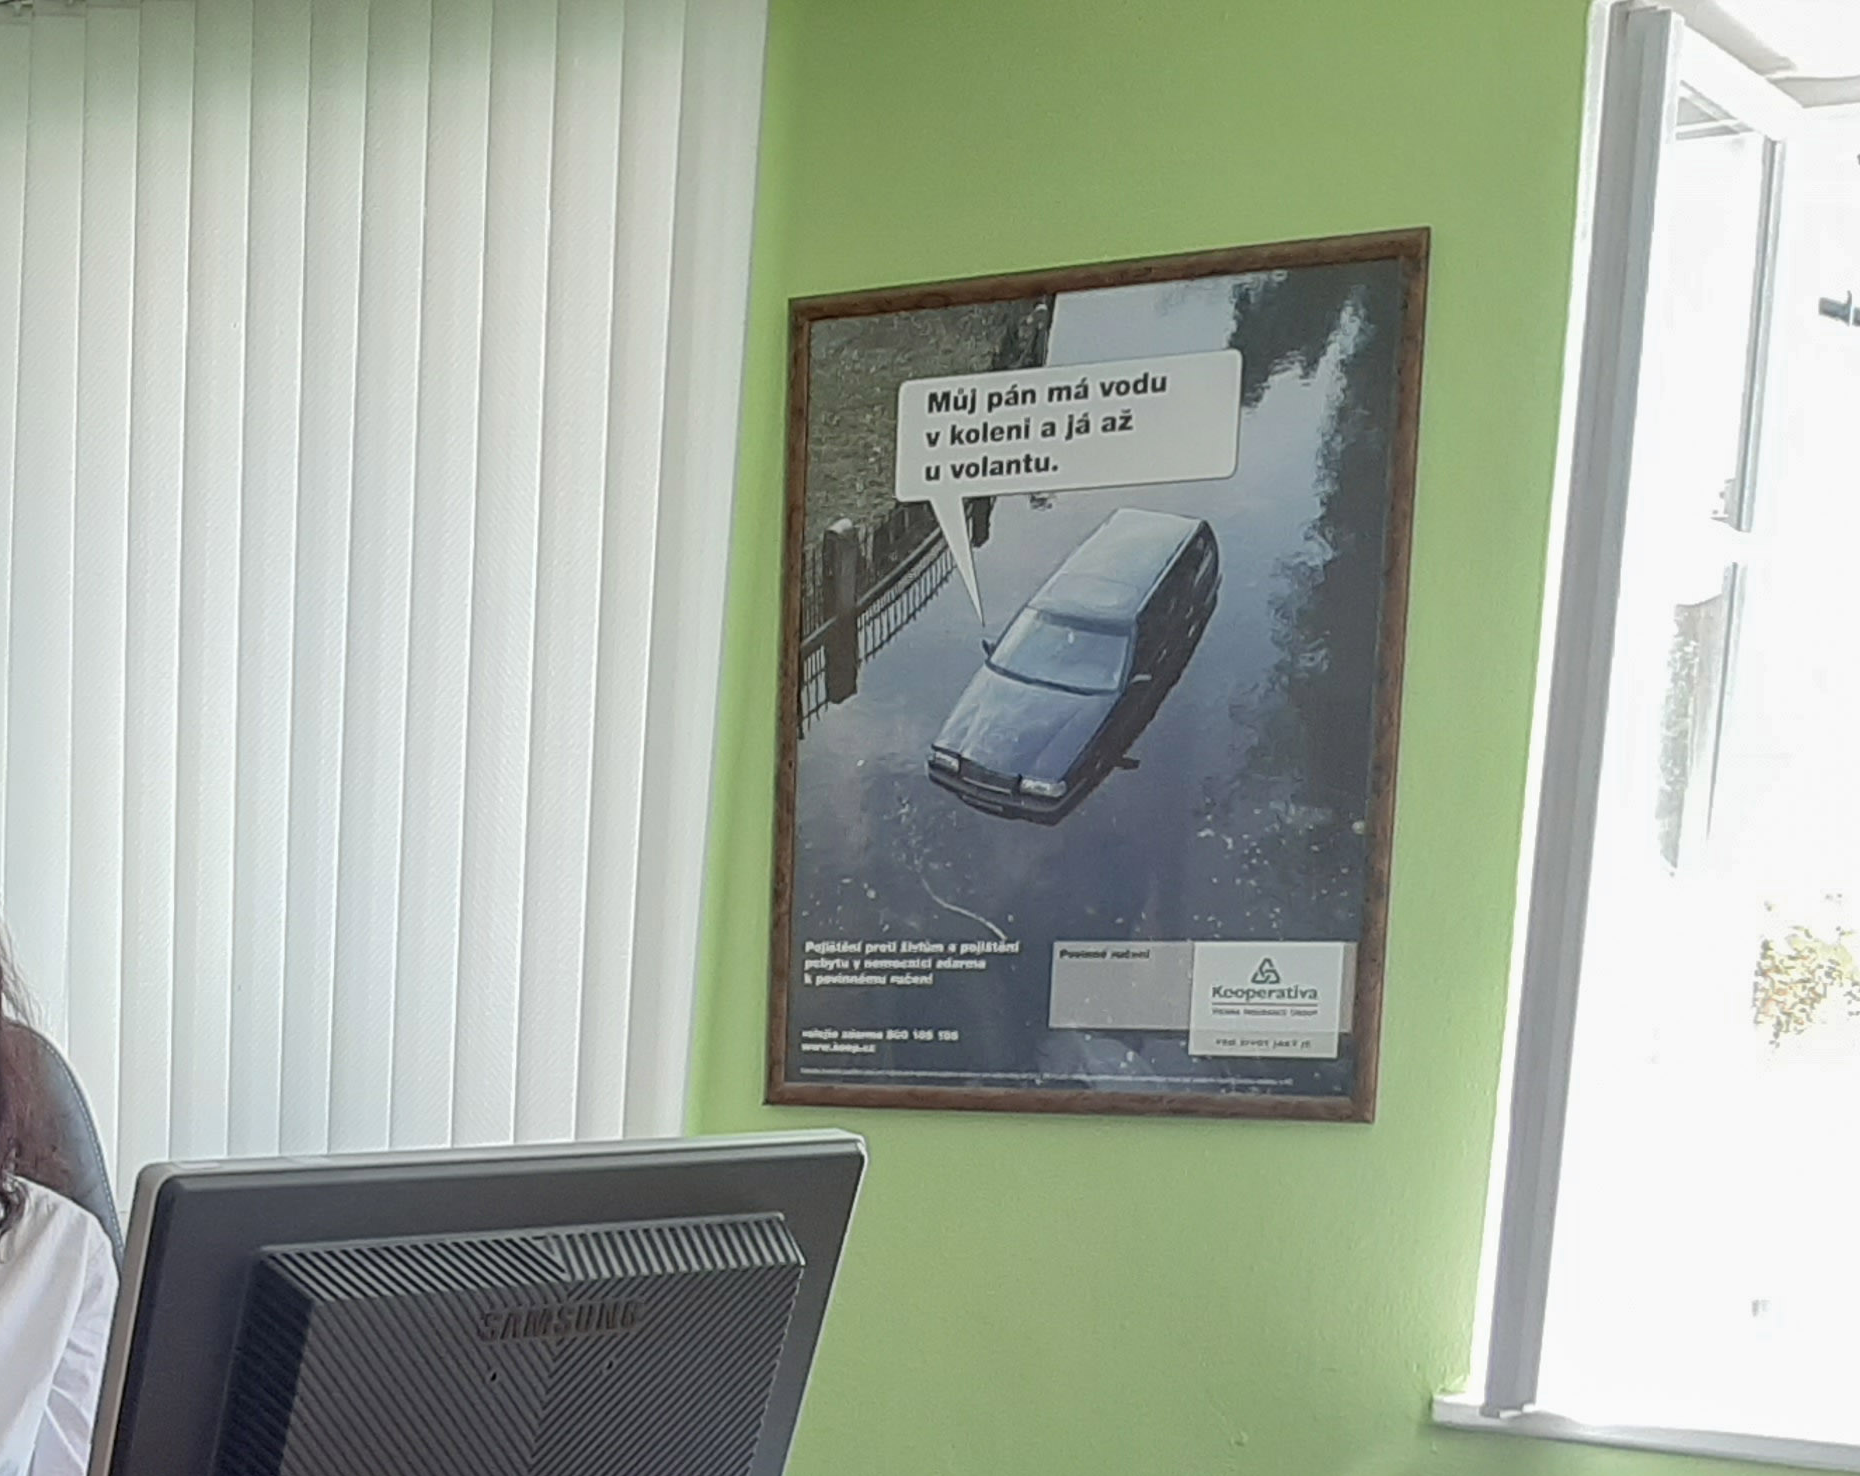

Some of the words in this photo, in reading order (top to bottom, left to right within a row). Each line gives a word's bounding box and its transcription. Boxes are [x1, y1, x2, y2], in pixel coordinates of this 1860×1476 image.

[927, 387, 977, 415] Můj
[987, 384, 1037, 413] pán
[1047, 377, 1089, 402] má
[1100, 372, 1167, 397] vodu
[925, 430, 941, 447] v
[950, 417, 1031, 446] koleni
[1040, 421, 1057, 438] a
[1065, 412, 1091, 441] já
[1101, 409, 1134, 433] až
[925, 465, 941, 482] u
[951, 453, 1059, 479] volantu.
[1211, 985, 1318, 1003] Kooperativa
[477, 1302, 639, 1341] SAMSUNG
